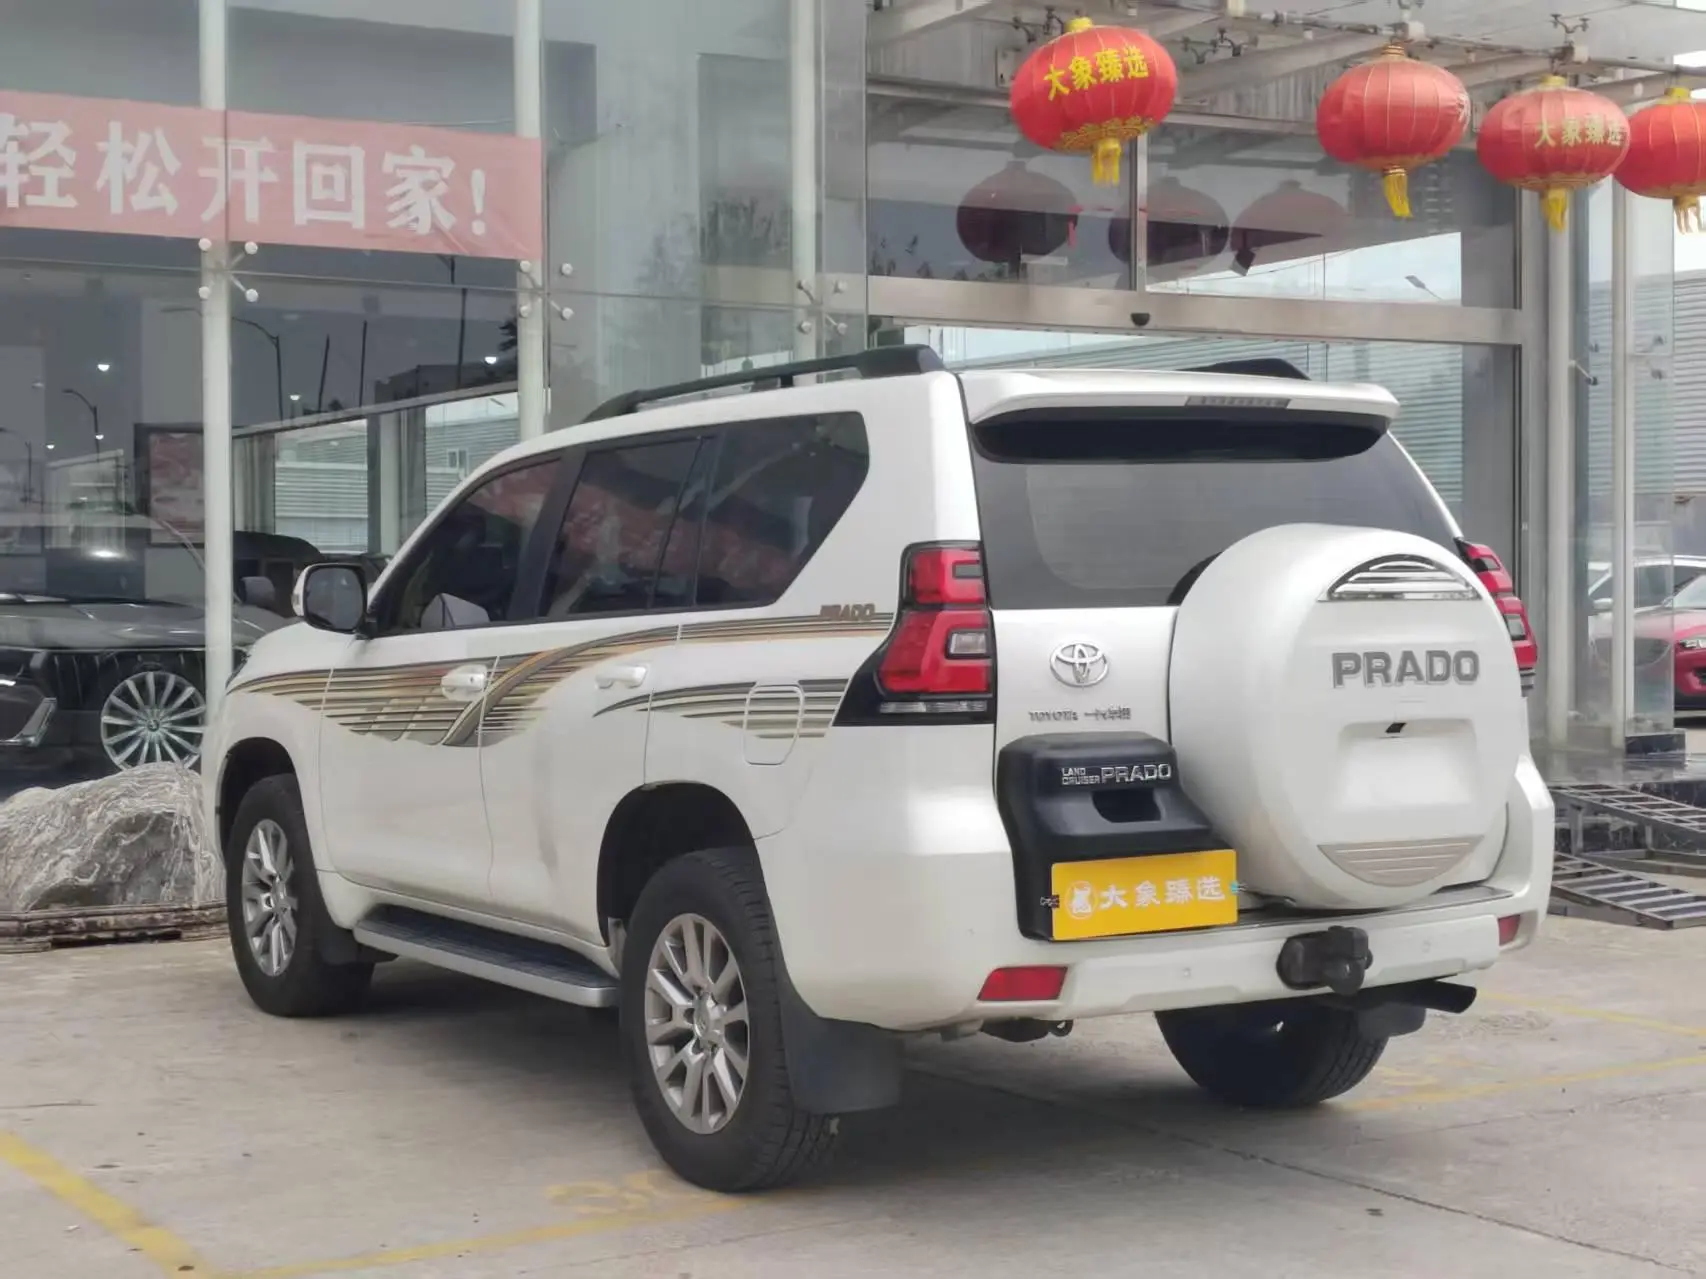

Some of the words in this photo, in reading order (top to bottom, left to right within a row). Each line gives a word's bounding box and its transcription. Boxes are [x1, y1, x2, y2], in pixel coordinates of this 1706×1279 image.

[1043, 44, 1149, 101] 大象臻选
[820, 603, 876, 621] PRADO
[1331, 650, 1480, 689] PRADO
[1061, 767, 1086, 777] LAND
[1061, 775, 1101, 786] CRUISER
[1100, 763, 1172, 784] PRADO
[1100, 875, 1225, 910] 大象臻选
